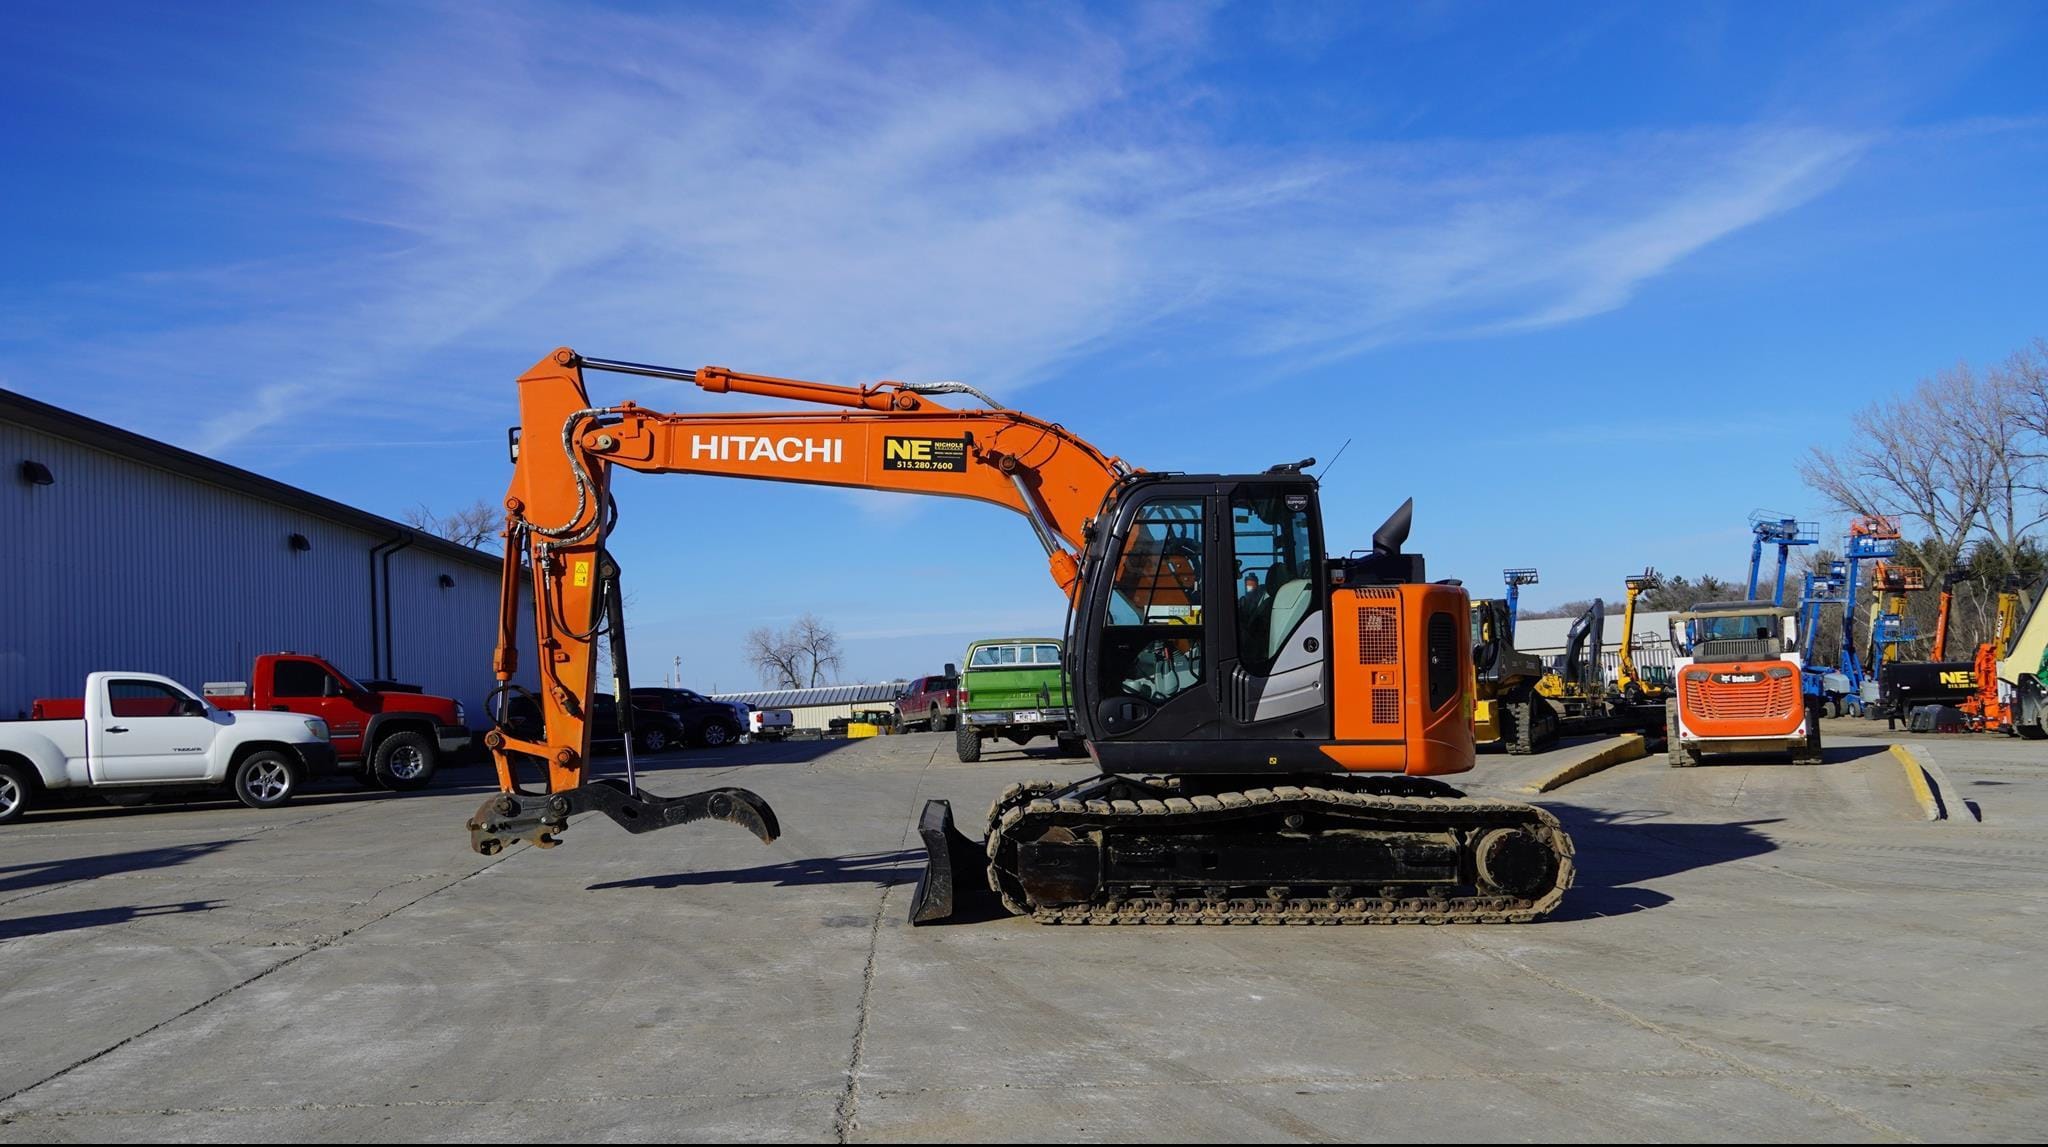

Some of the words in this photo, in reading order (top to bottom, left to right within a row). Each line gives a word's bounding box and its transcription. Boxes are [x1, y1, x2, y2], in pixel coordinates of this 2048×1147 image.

[691, 434, 843, 464] HITACHI
[886, 438, 932, 461] NE
[896, 460, 953, 470] 515.280.7600
[1731, 674, 1756, 683] Bobcat
[1939, 671, 1969, 685] NE
